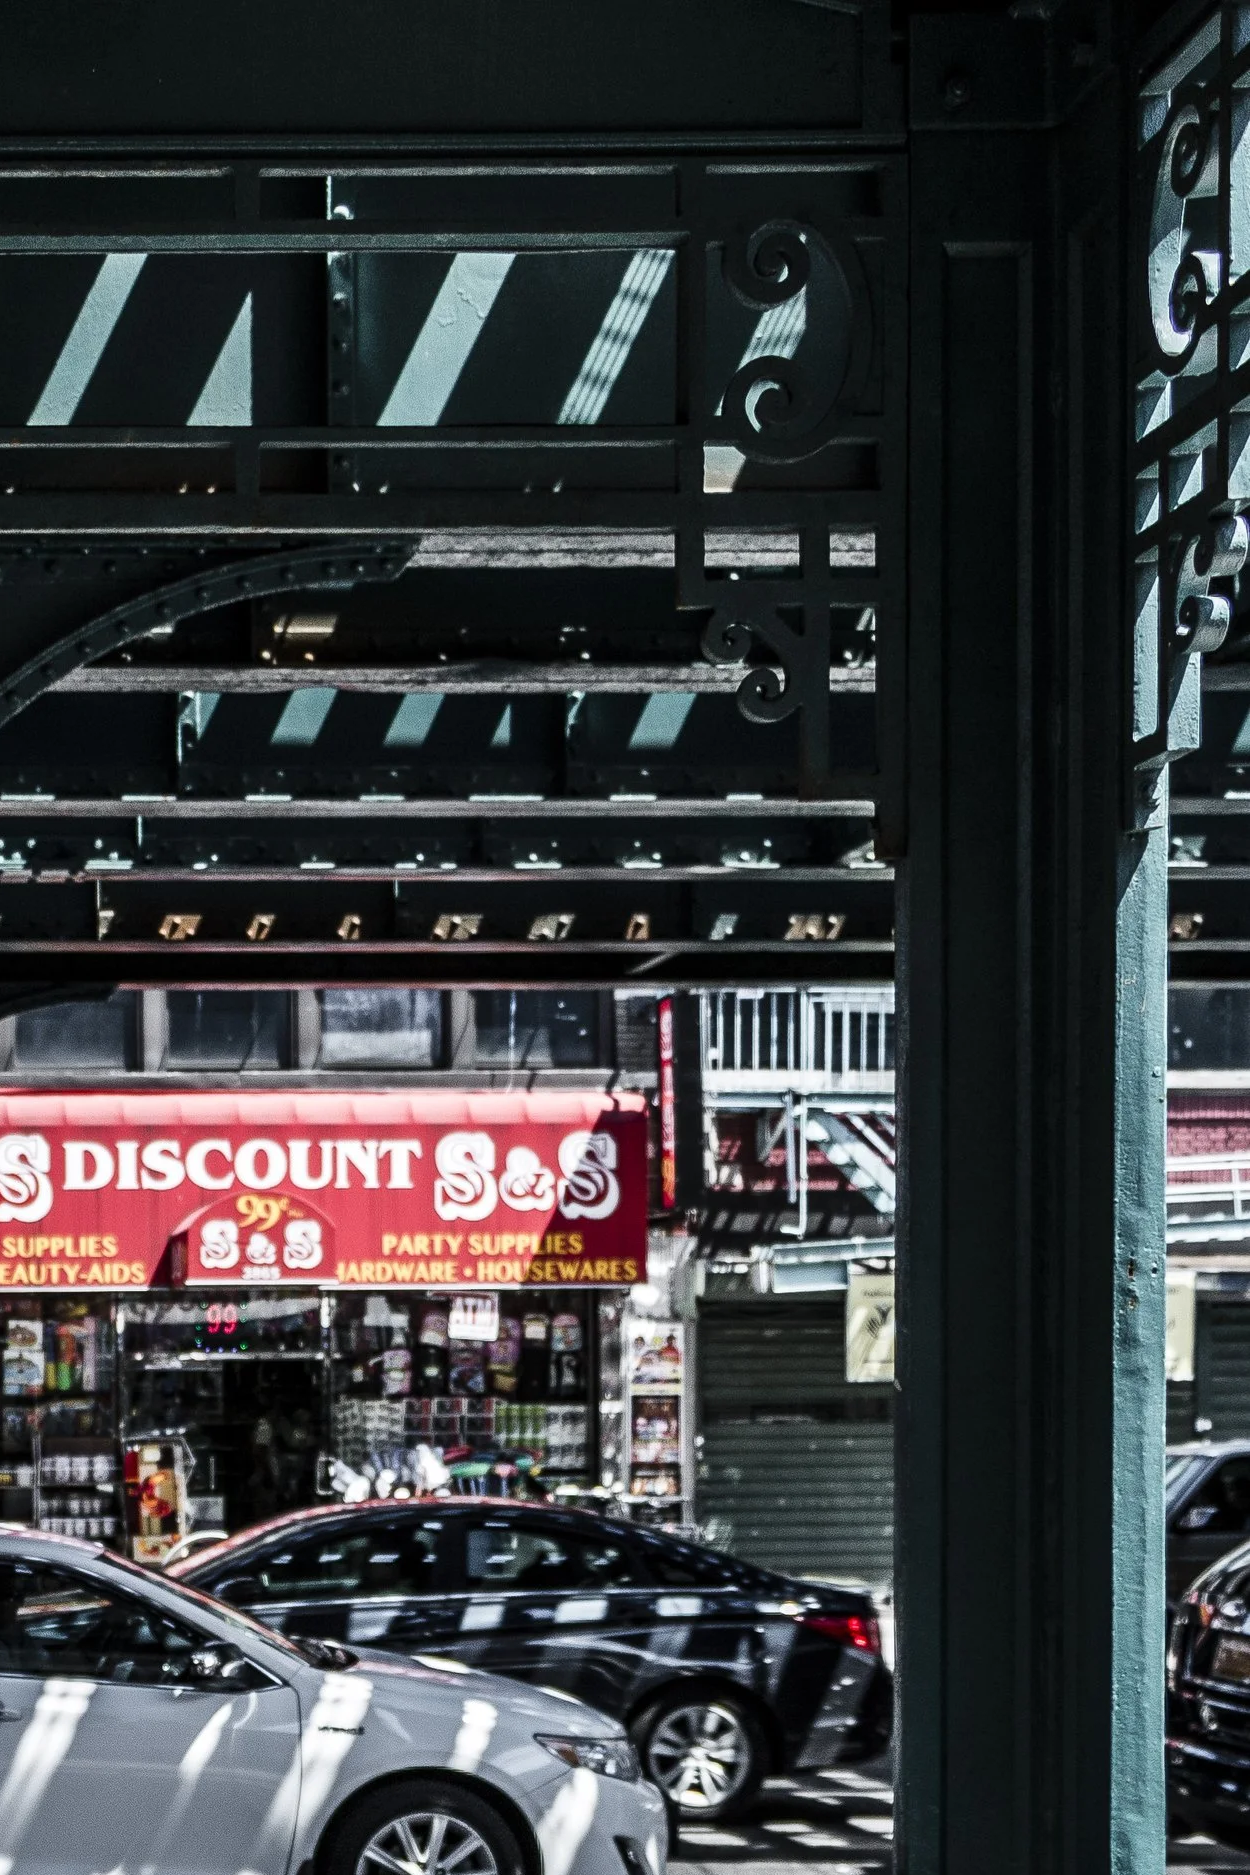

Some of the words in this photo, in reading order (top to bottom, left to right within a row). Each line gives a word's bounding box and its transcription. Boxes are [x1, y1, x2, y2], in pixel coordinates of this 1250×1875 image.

[62, 1139, 422, 1191] DISCOUNT
[2, 1235, 119, 1259] SUPPLIES
[381, 1233, 463, 1256] PARTY
[468, 1232, 584, 1256] SUPPLIES
[478, 1259, 639, 1283] HOUSEWARES
